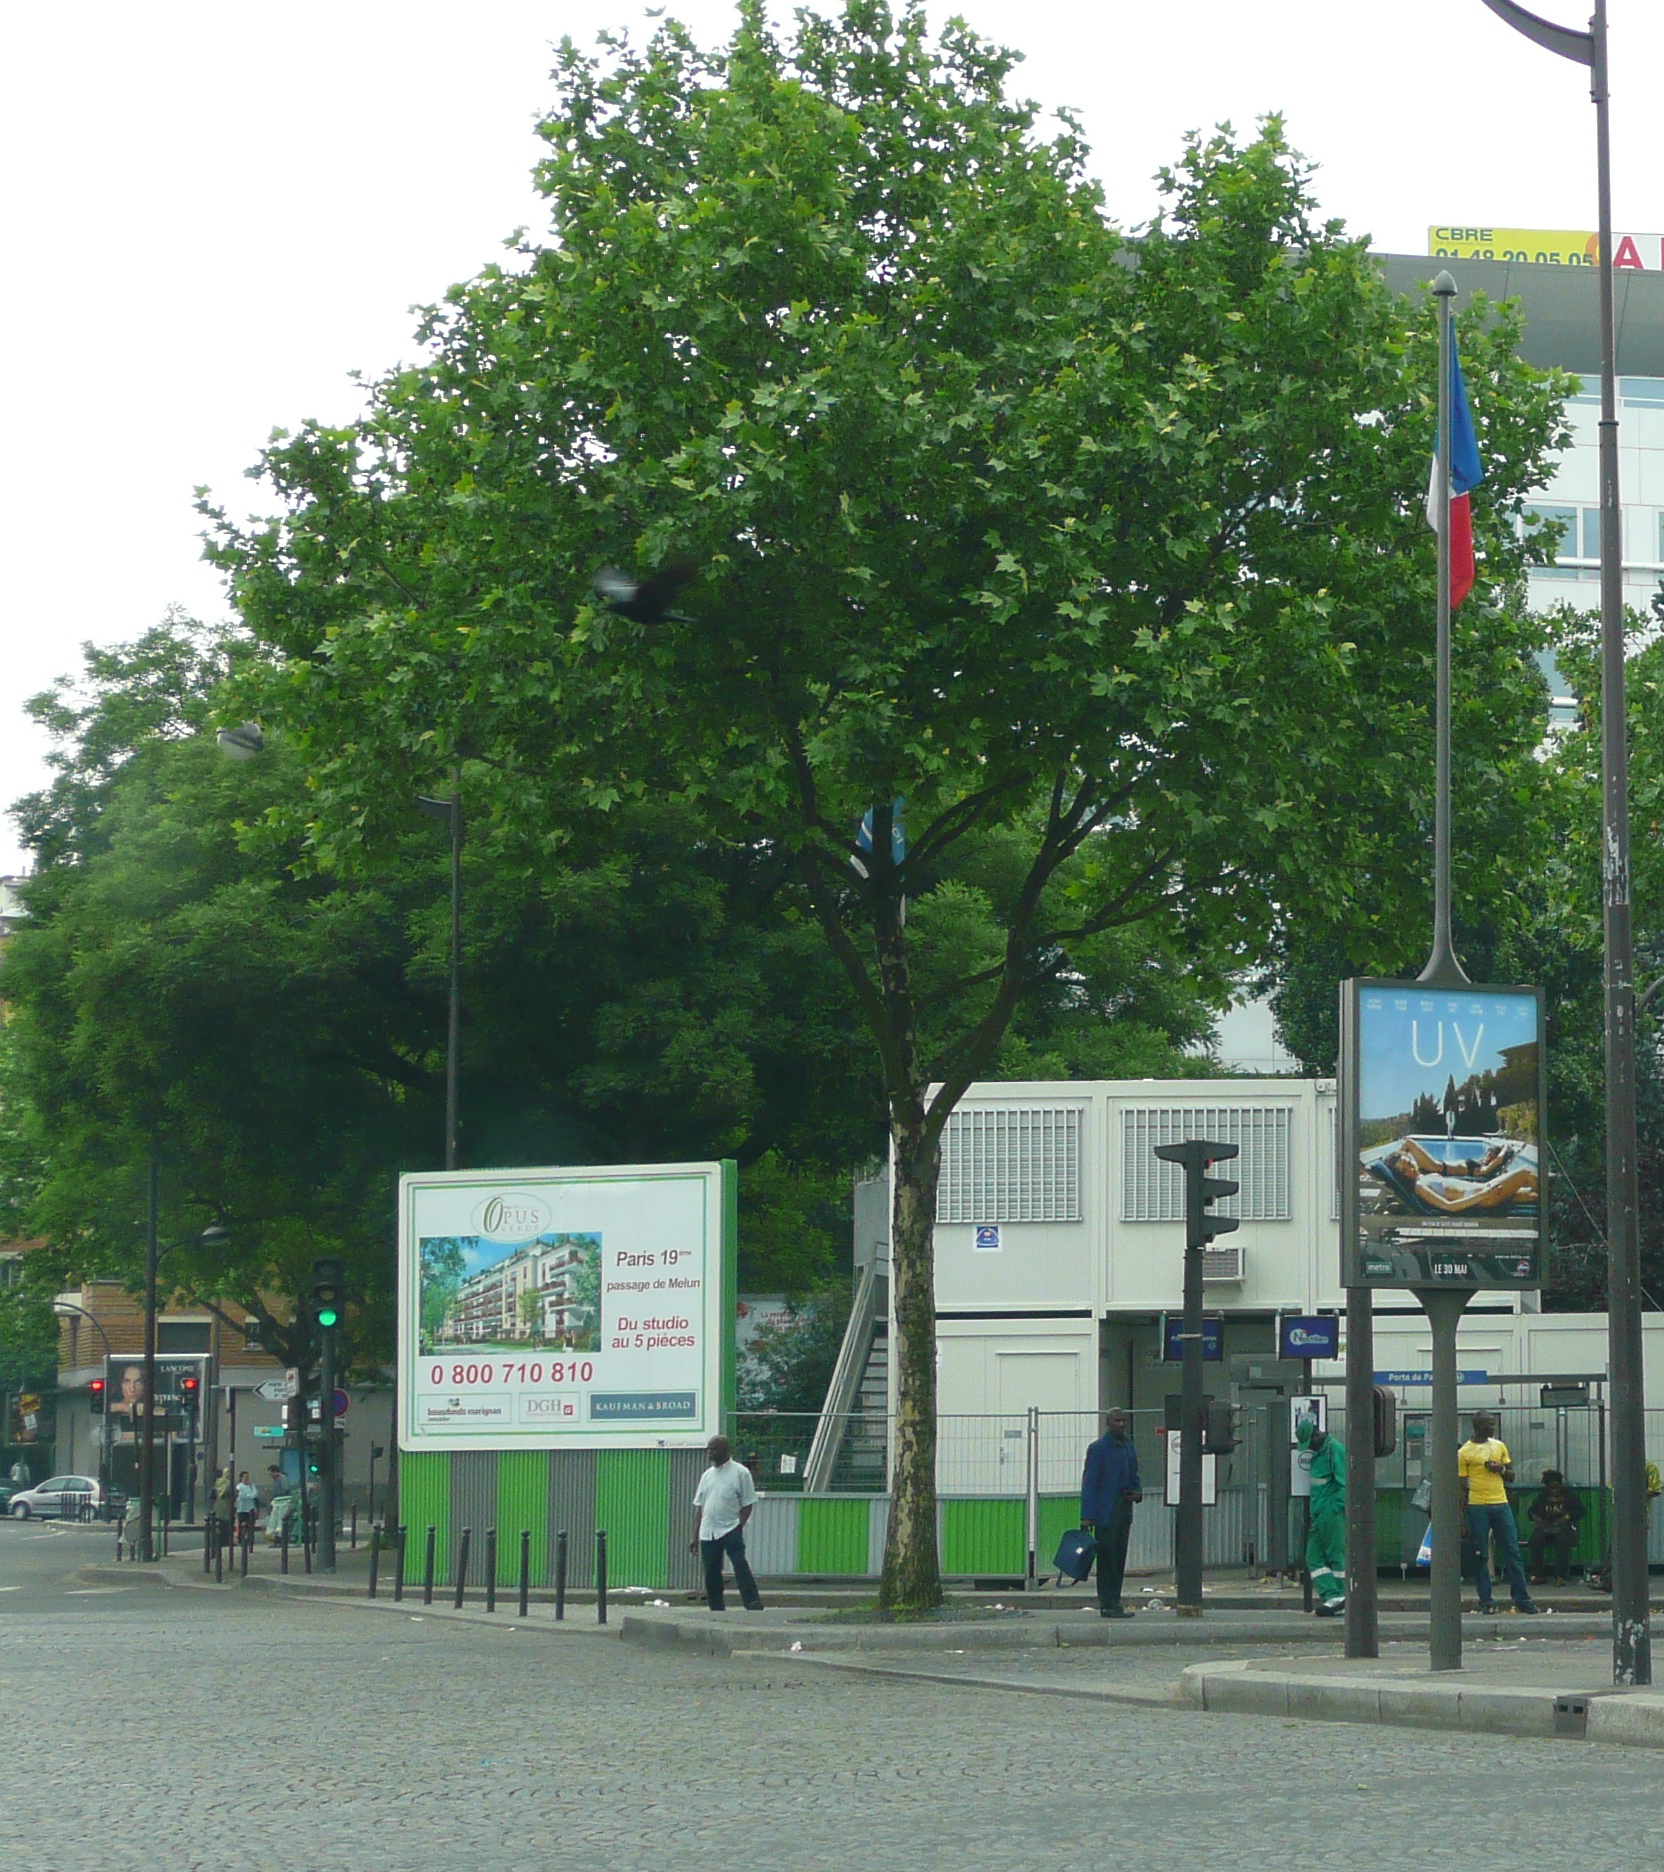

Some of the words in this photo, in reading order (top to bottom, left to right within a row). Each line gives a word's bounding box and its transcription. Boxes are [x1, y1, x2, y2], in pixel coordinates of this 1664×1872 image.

[1435, 228, 1494, 242] CBRE
[1612, 236, 1645, 270] A
[483, 1196, 539, 1234] OPUS
[616, 1250, 655, 1267] Paris
[1434, 1263, 1442, 1274] LE
[1443, 1263, 1453, 1274] 30
[1454, 1263, 1468, 1275] MAI
[607, 1281, 650, 1293] passage
[653, 1278, 666, 1289] de
[668, 1277, 701, 1289] Melun
[618, 1317, 638, 1331] Du
[642, 1315, 689, 1330] studio
[611, 1336, 630, 1349] au
[634, 1333, 644, 1348] 5
[646, 1333, 696, 1352] pièces
[431, 1364, 444, 1385] 0
[452, 1363, 493, 1385] 800
[502, 1362, 543, 1384] 710
[551, 1361, 593, 1383] 810
[527, 1398, 561, 1413] DGH
[596, 1402, 646, 1411] KAUFMAN
[656, 1401, 691, 1410] BROAD
